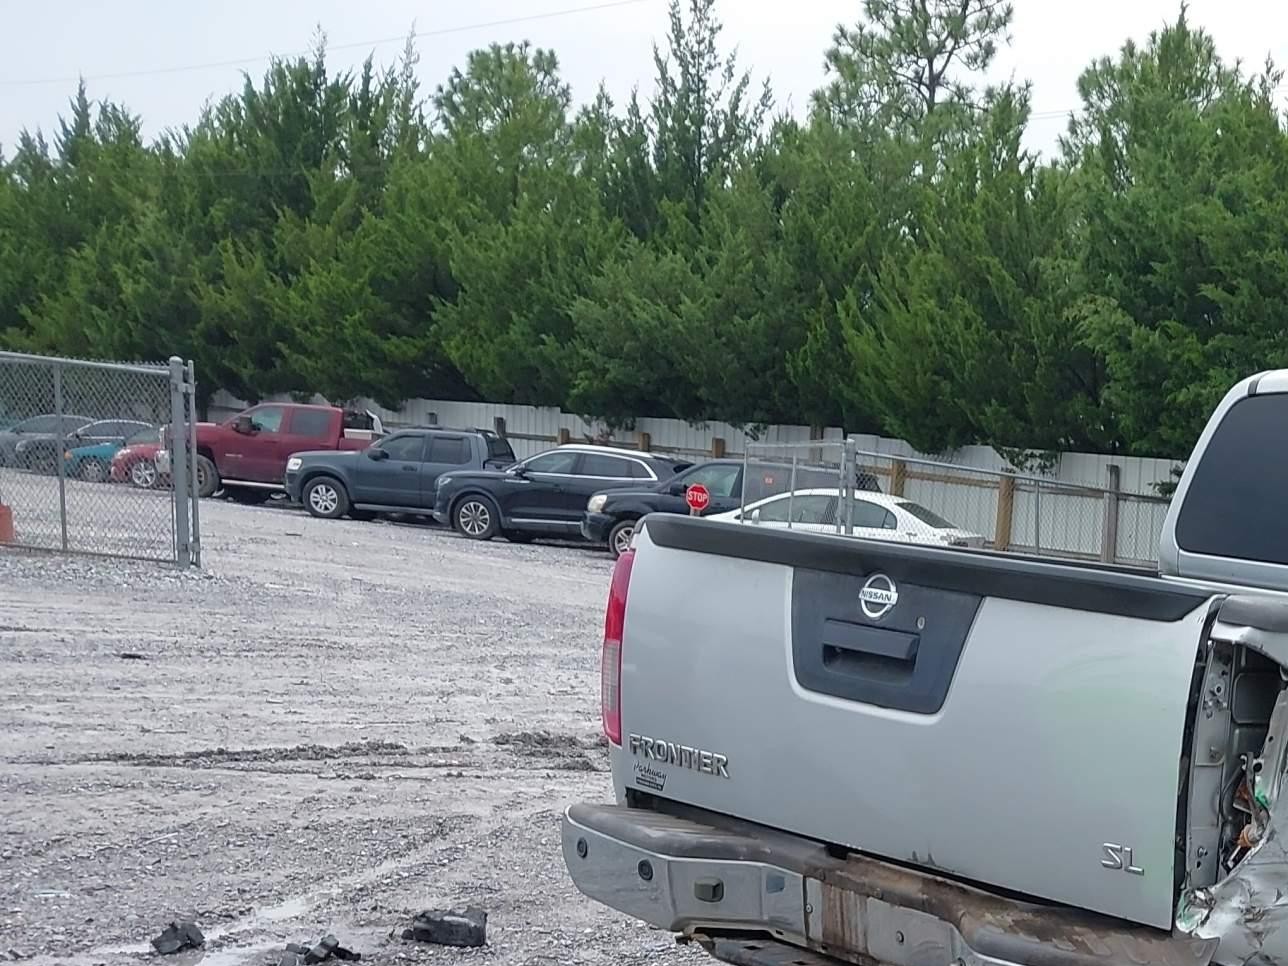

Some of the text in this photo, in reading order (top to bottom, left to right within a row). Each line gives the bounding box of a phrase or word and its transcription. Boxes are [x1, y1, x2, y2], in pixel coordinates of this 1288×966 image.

[688, 491, 708, 503] STOP
[861, 590, 892, 602] NISSAN
[629, 733, 730, 779] FRONTIER
[1101, 842, 1144, 876] SL
